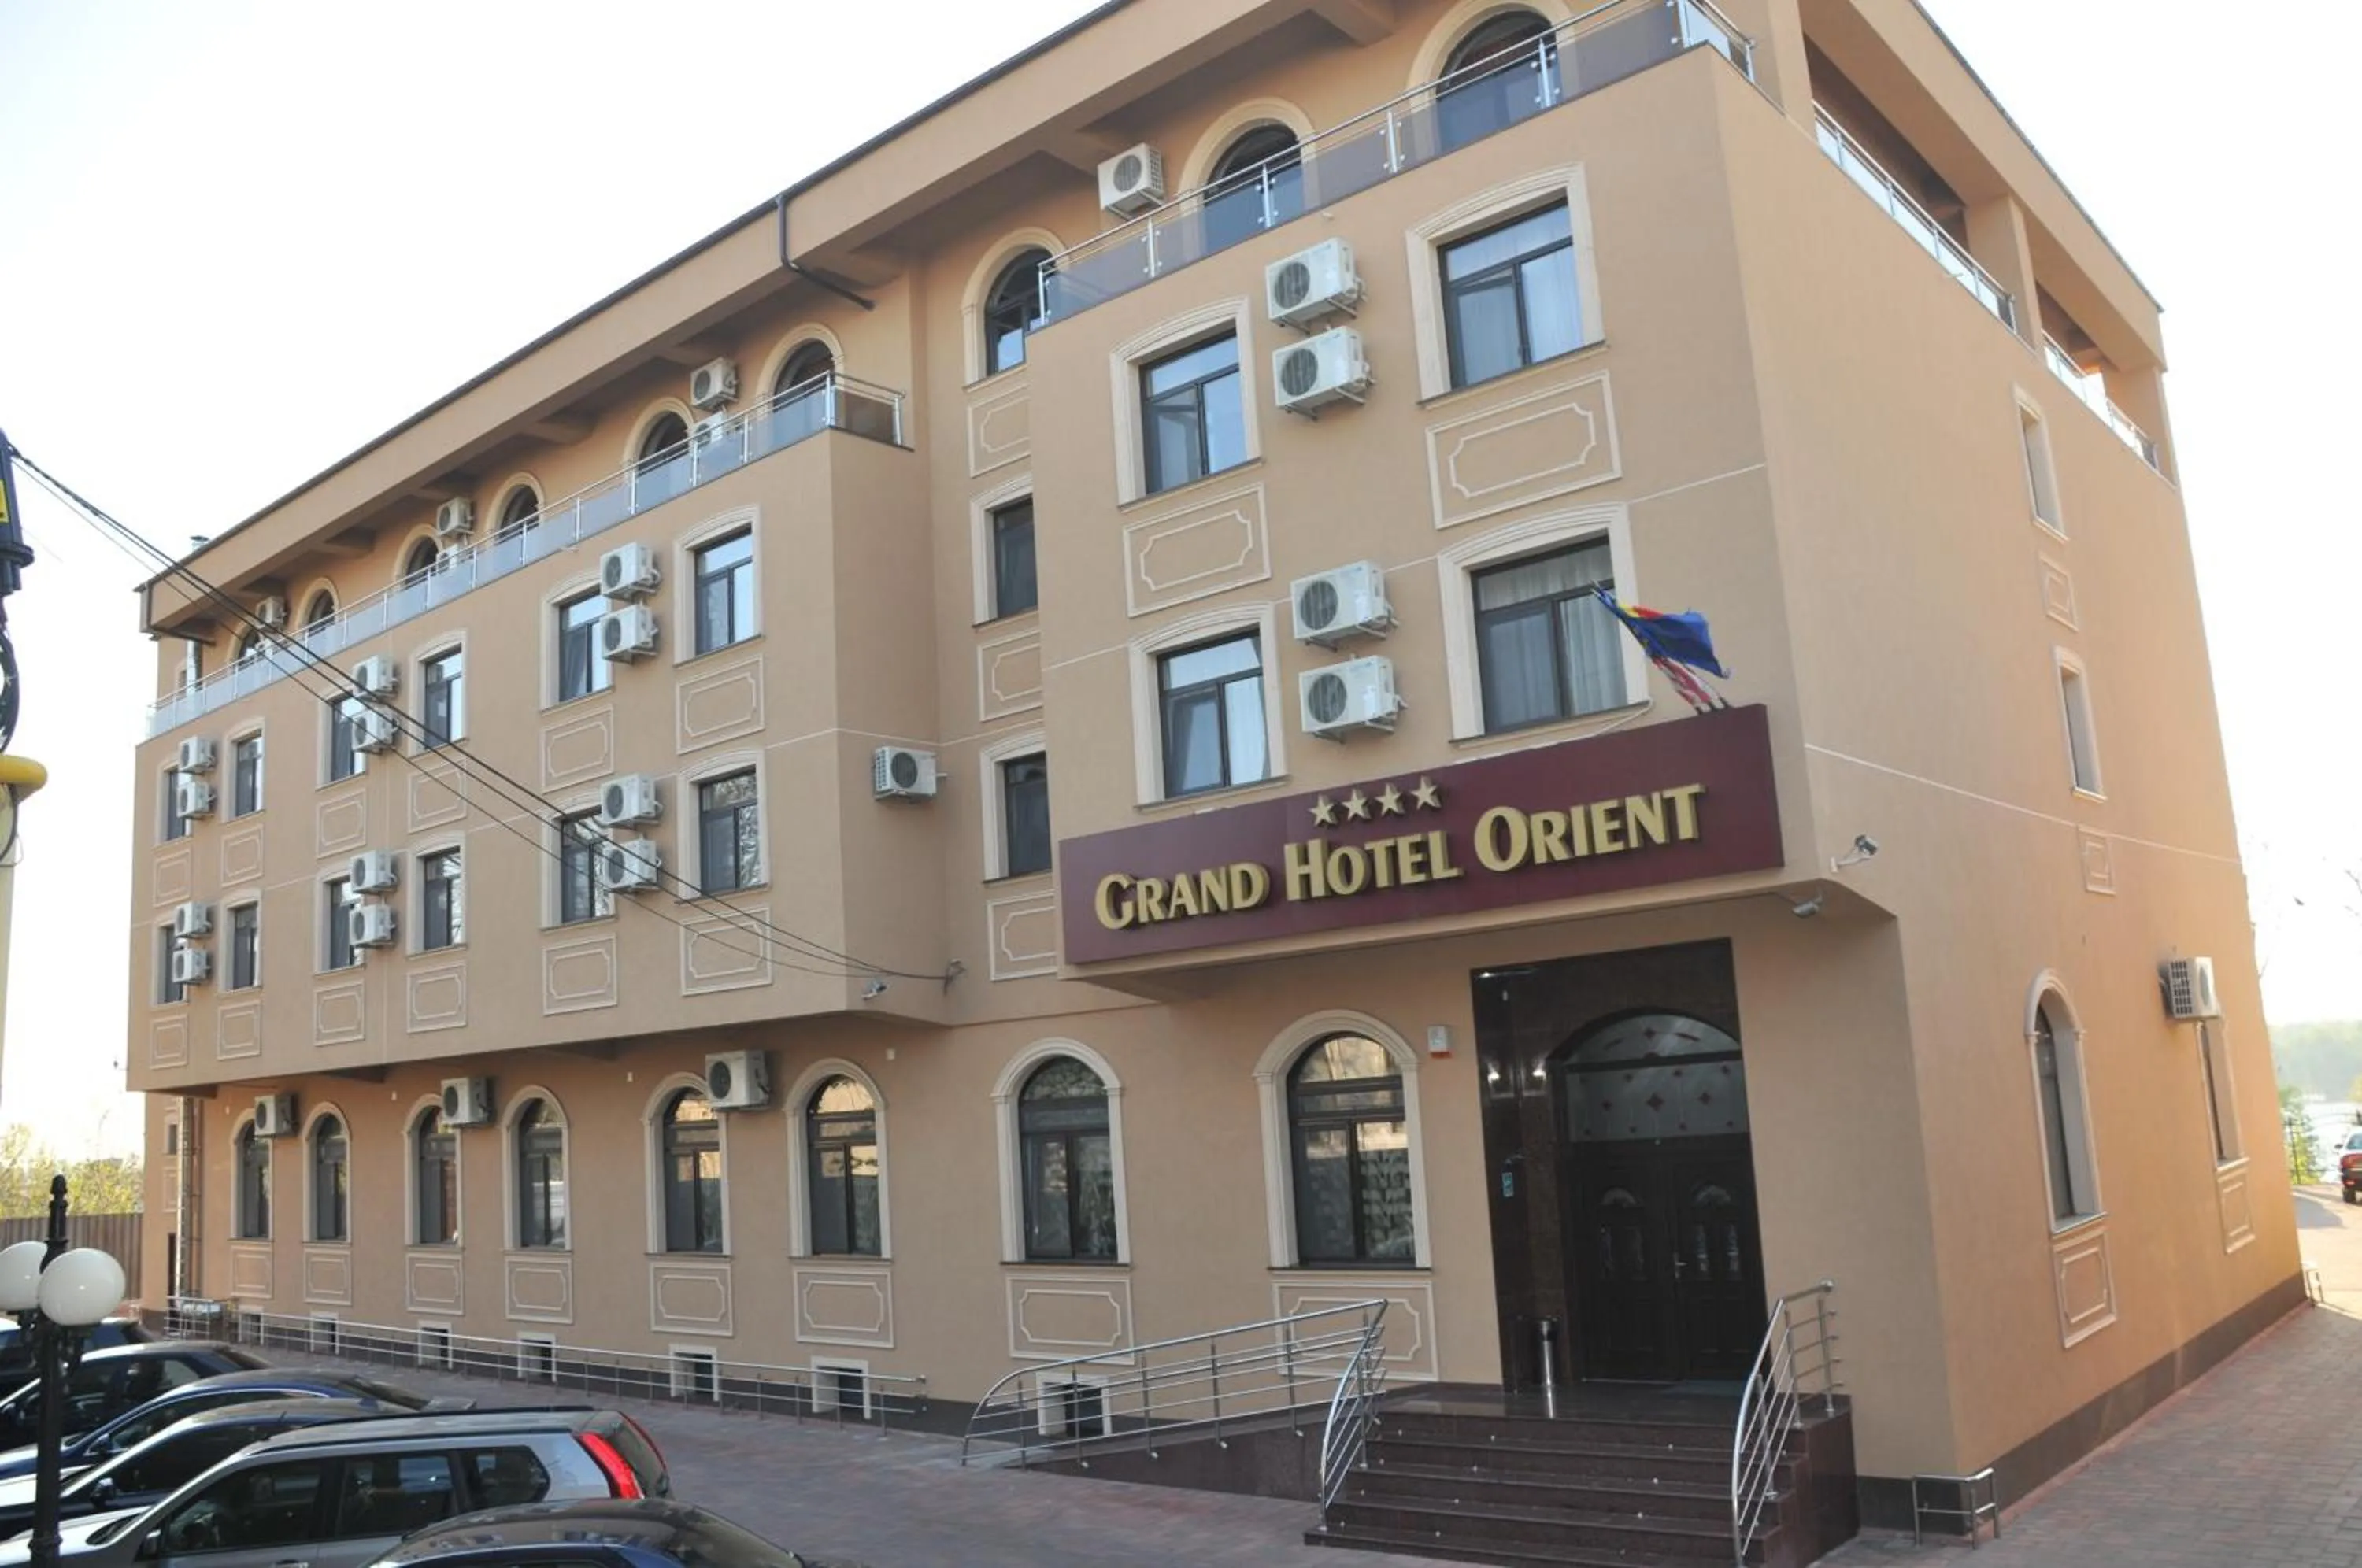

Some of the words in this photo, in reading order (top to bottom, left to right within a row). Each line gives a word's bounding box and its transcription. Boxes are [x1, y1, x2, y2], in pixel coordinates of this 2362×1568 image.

[1095, 862, 1269, 930] GRAND
[1284, 830, 1462, 900] HOTEL
[1475, 784, 1705, 872] ORIENT
